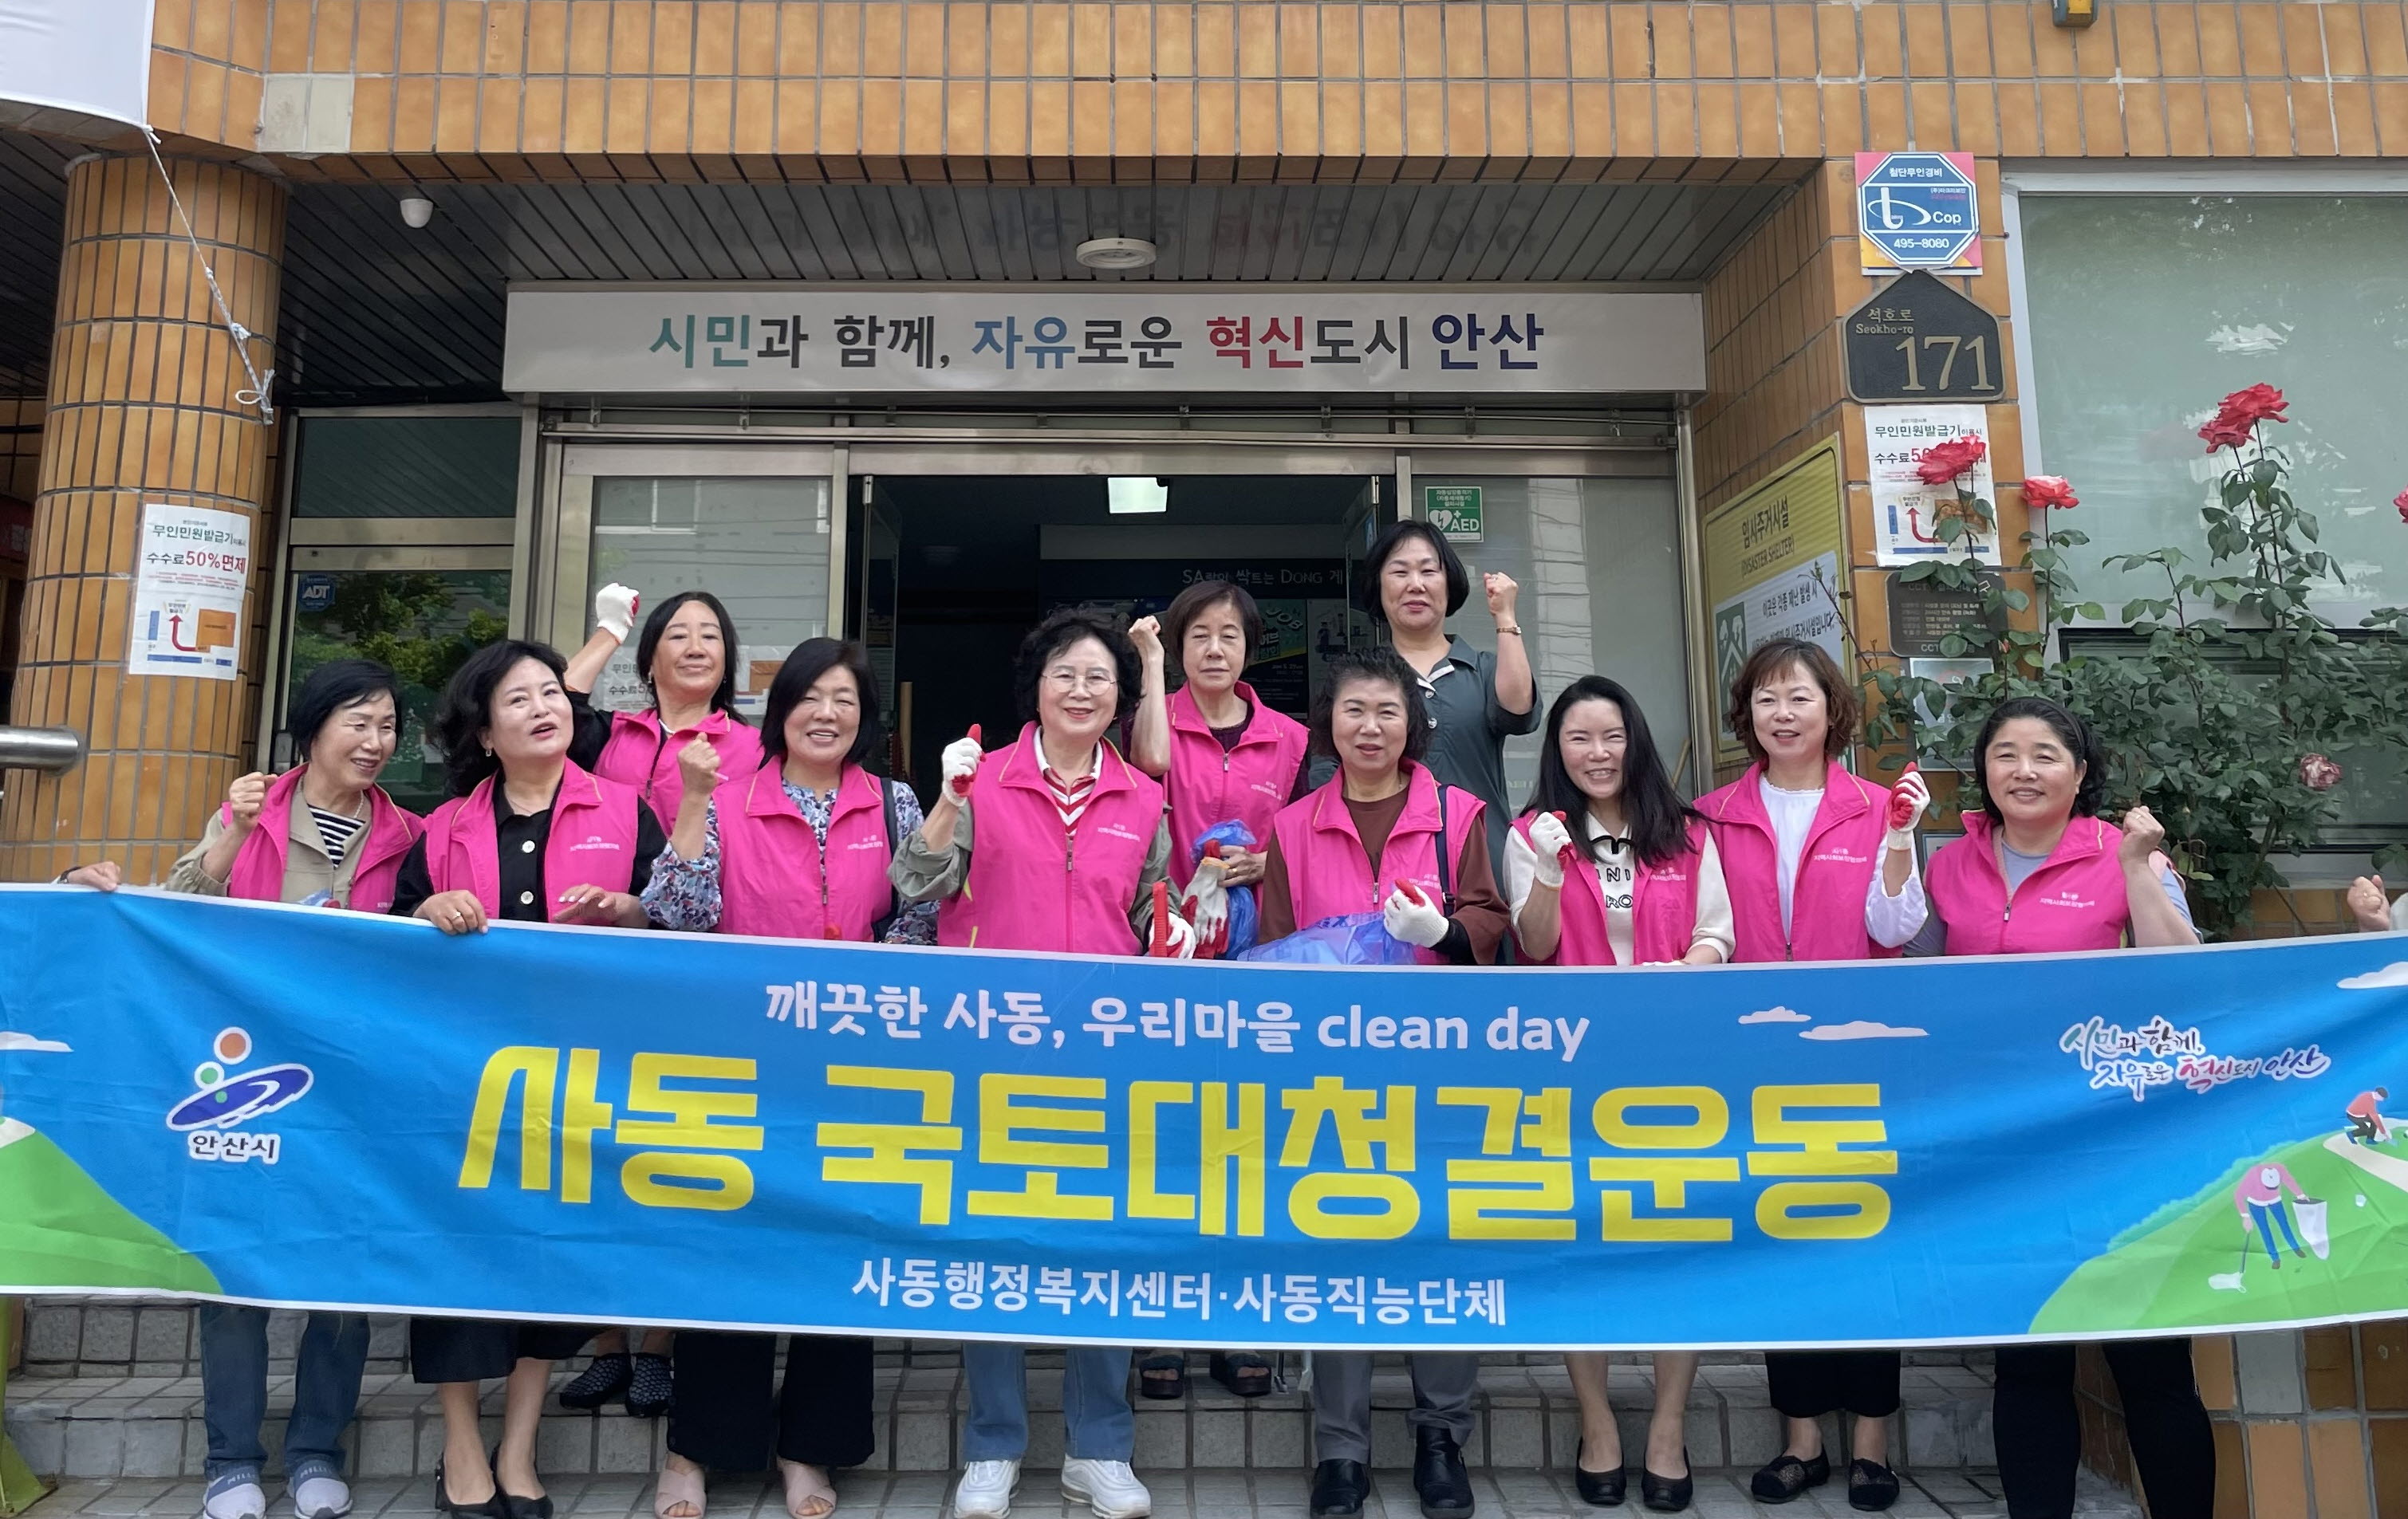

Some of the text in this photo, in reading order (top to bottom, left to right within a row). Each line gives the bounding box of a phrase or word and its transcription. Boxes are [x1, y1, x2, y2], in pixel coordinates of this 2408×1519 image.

[1932, 211, 1962, 225] Cop
[1894, 238, 1949, 249] 495-8080
[1867, 307, 1914, 323] 석호로
[1855, 323, 1914, 334] Seokho-ro
[649, 313, 1545, 370] 시민과 함께, 자유로운 혁신도시 안산
[1895, 335, 1996, 391] 171
[1874, 424, 1961, 438] 무인민원발급기
[1450, 518, 1480, 532] AED
[1741, 494, 1790, 550] 임시주거시설
[153, 525, 233, 545] 무인민원발급기
[1281, 569, 1322, 584] DONG
[302, 584, 330, 599] ADT
[766, 981, 1590, 1062] 깨끗한 사동, 우리마을 clean day
[2063, 1019, 2142, 1067] 시민과
[2094, 1046, 2327, 1099] 자유로운 혁신도시 안산
[191, 1132, 278, 1164] 안산시
[459, 1045, 1898, 1242] 사동 국토대청결운동
